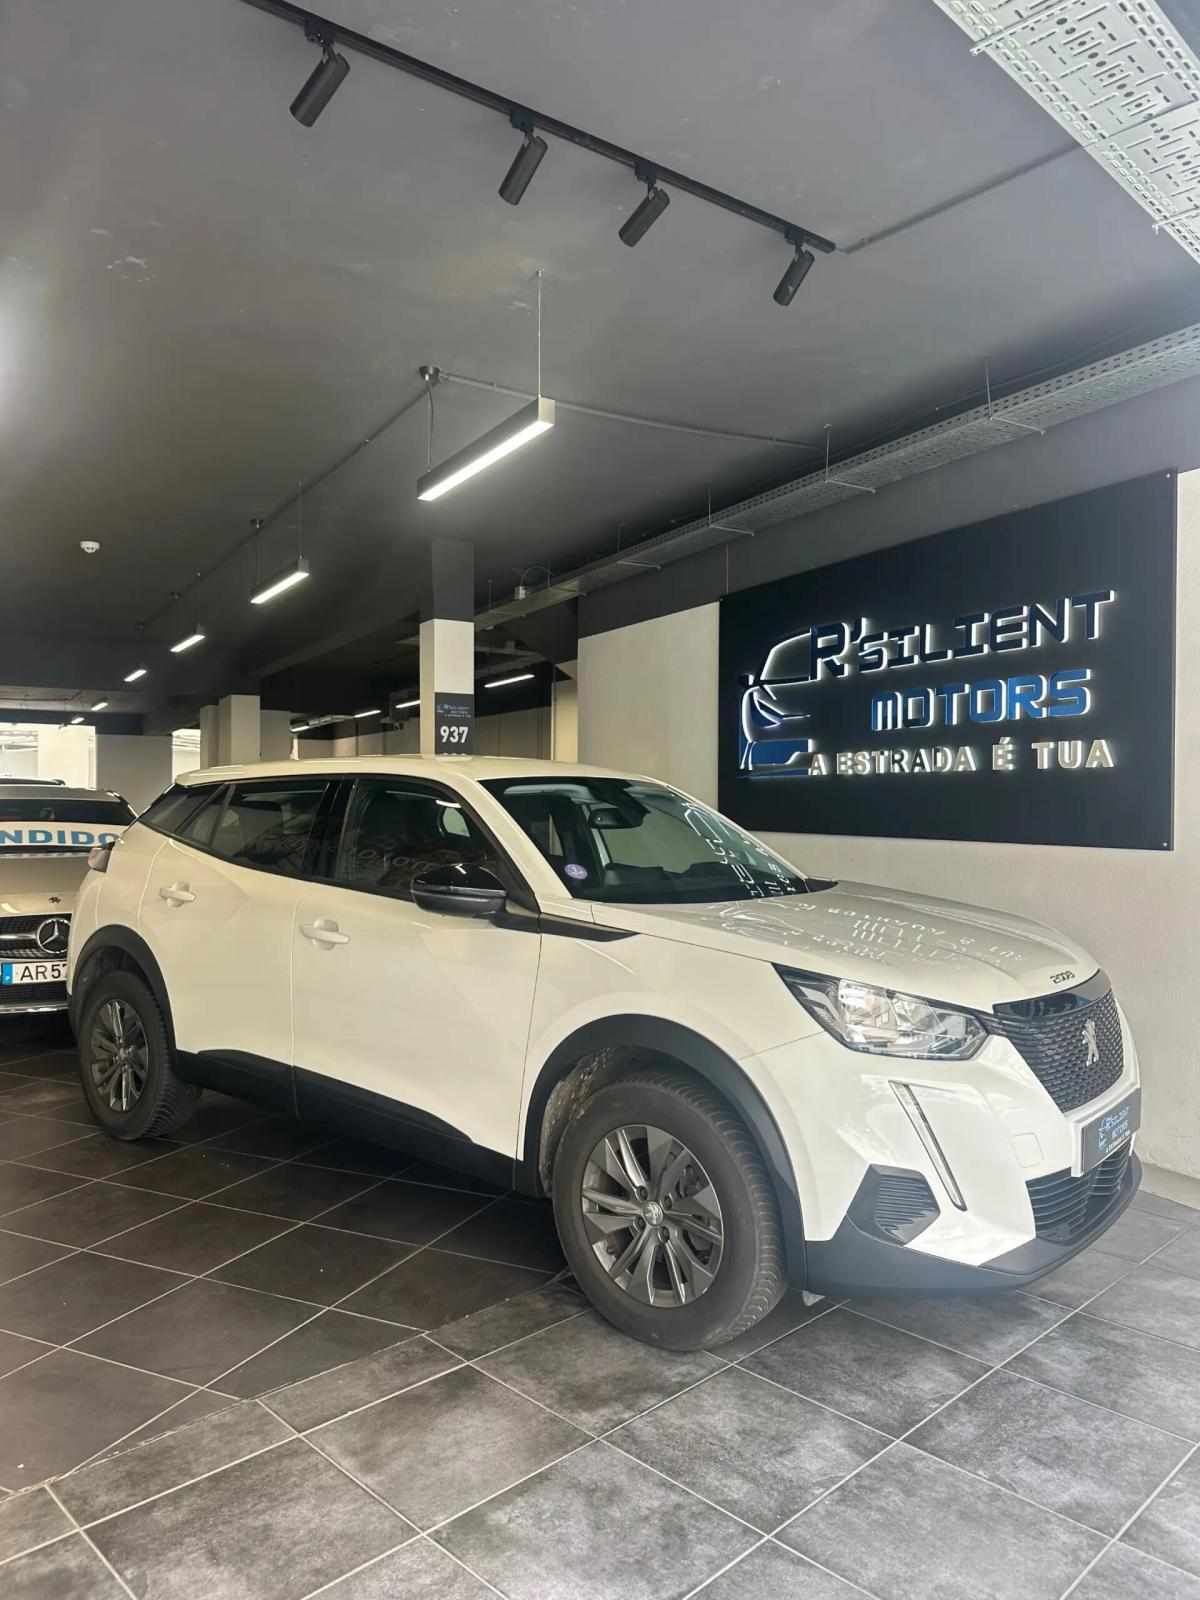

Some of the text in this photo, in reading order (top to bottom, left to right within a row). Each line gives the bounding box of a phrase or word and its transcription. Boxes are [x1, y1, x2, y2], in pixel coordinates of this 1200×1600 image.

[871, 668, 1092, 732] MOTORS
[440, 725, 469, 743] 937
[808, 737, 1115, 776] A ESTRADA É TUA
